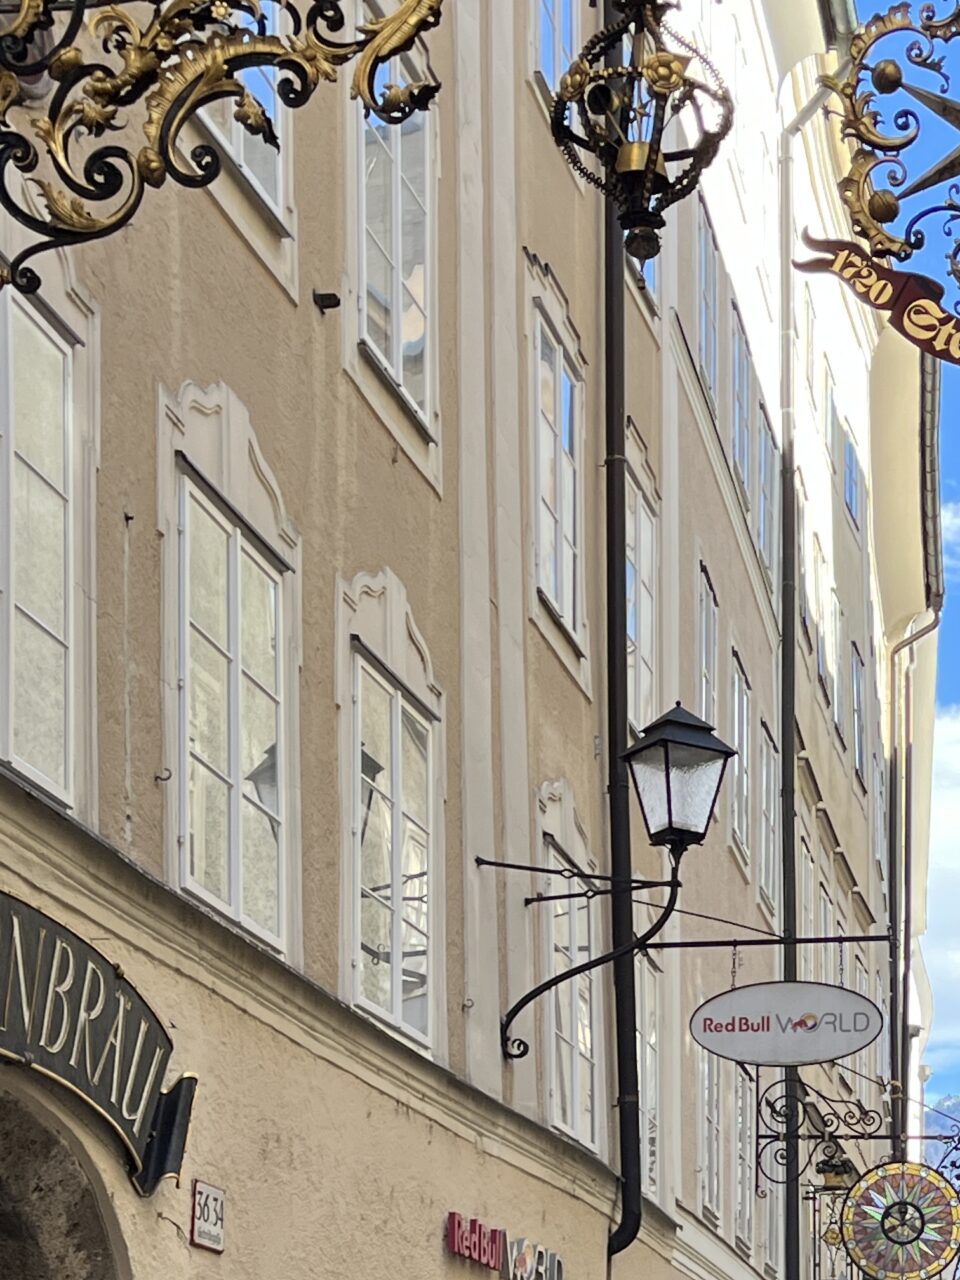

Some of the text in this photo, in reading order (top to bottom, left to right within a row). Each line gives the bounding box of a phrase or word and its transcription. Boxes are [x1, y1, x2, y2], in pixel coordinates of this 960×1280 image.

[828, 249, 894, 305] 1720
[703, 1012, 871, 1034] Red Bull WORLD
[448, 1212, 480, 1261] Red
[478, 1223, 504, 1272] Bull
